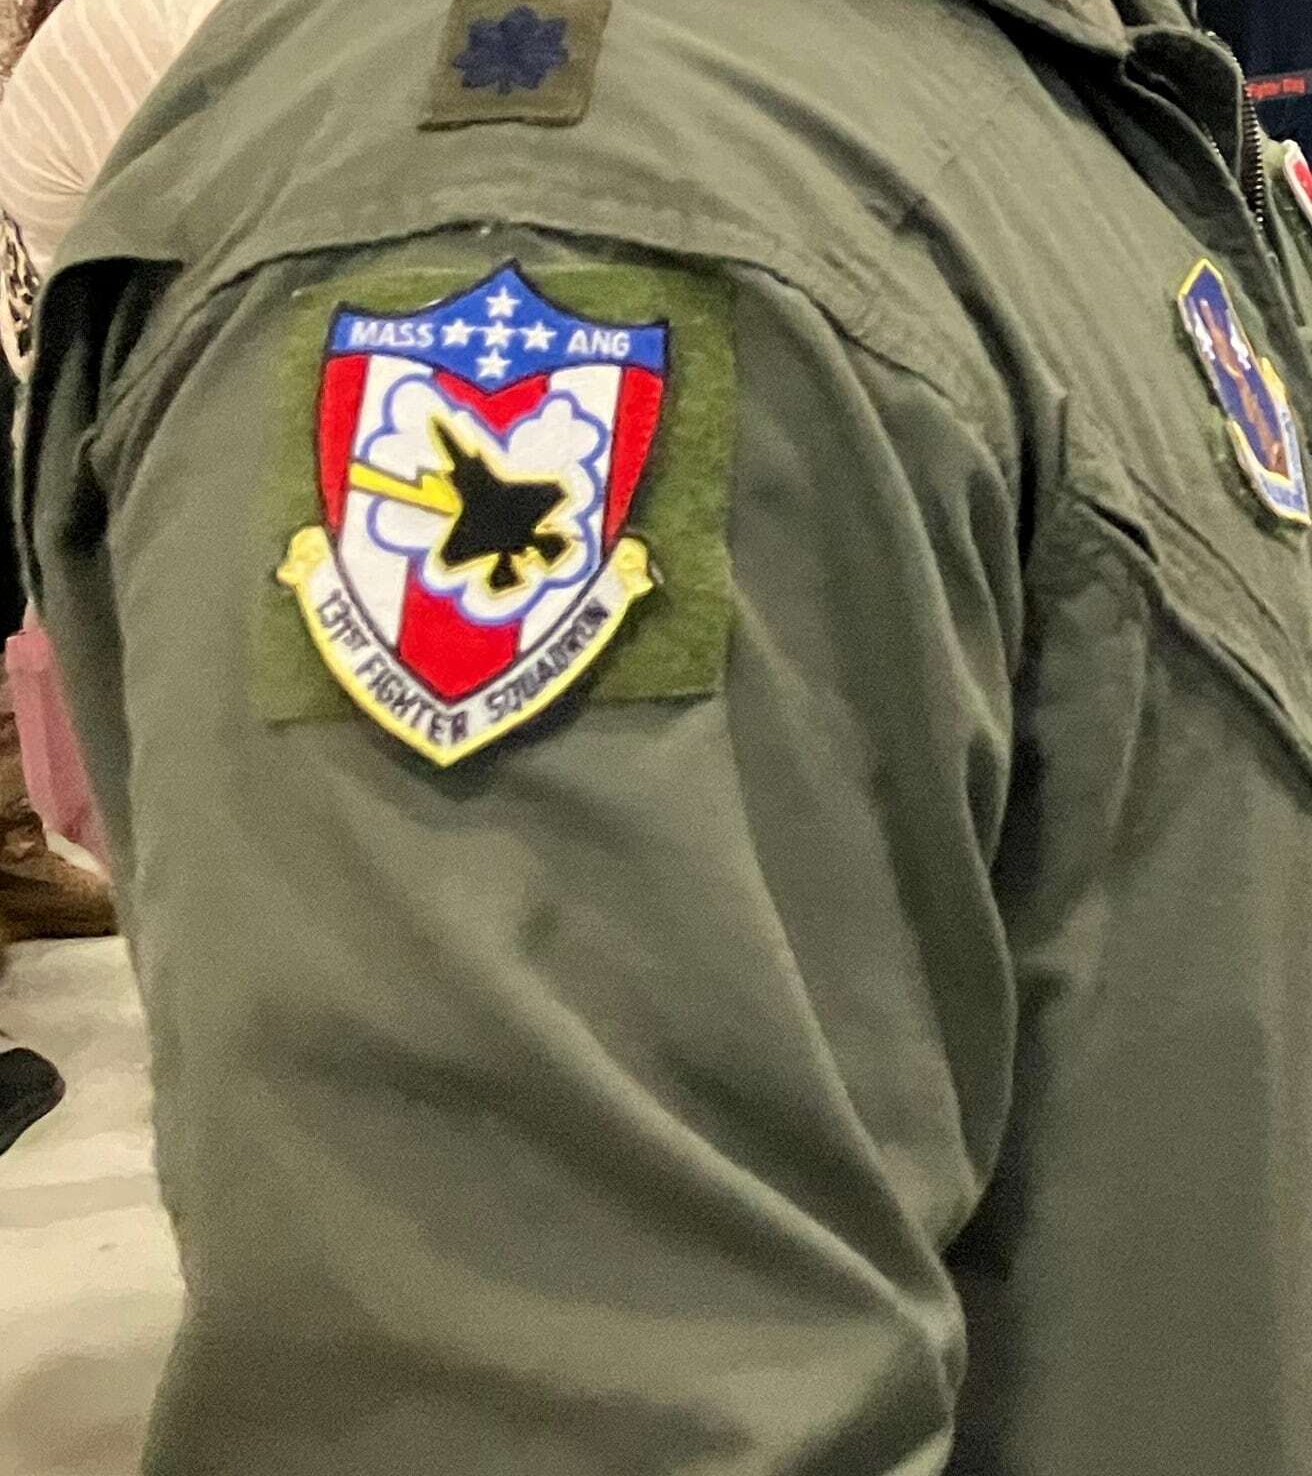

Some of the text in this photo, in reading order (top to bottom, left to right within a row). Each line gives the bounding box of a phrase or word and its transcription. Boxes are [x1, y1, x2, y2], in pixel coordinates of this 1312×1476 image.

[350, 320, 631, 360] MASS ANG
[355, 652, 470, 746] FIGHTER
